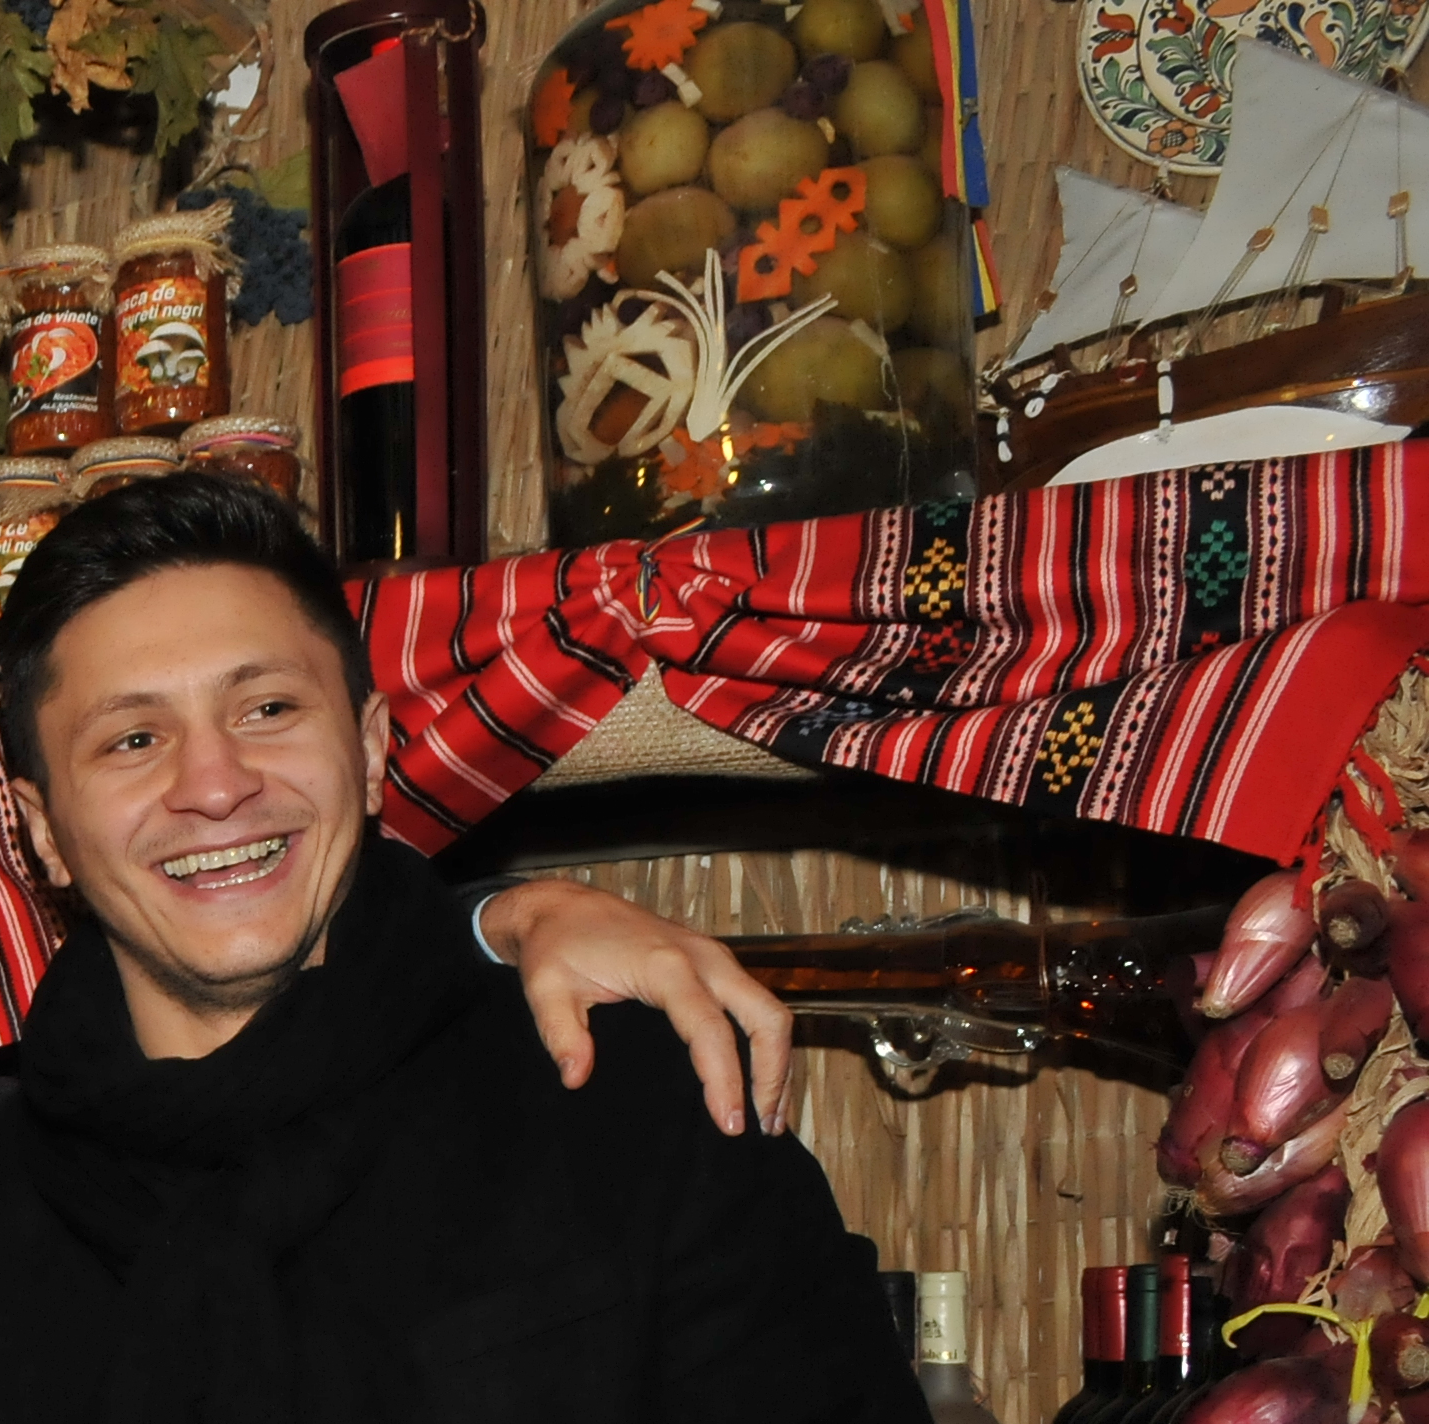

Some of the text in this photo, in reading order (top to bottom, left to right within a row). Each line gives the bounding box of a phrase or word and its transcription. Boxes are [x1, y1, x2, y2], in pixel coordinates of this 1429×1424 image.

[151, 284, 176, 302] de
[34, 311, 52, 325] de
[55, 309, 98, 325] vinete
[162, 303, 204, 320] negri
